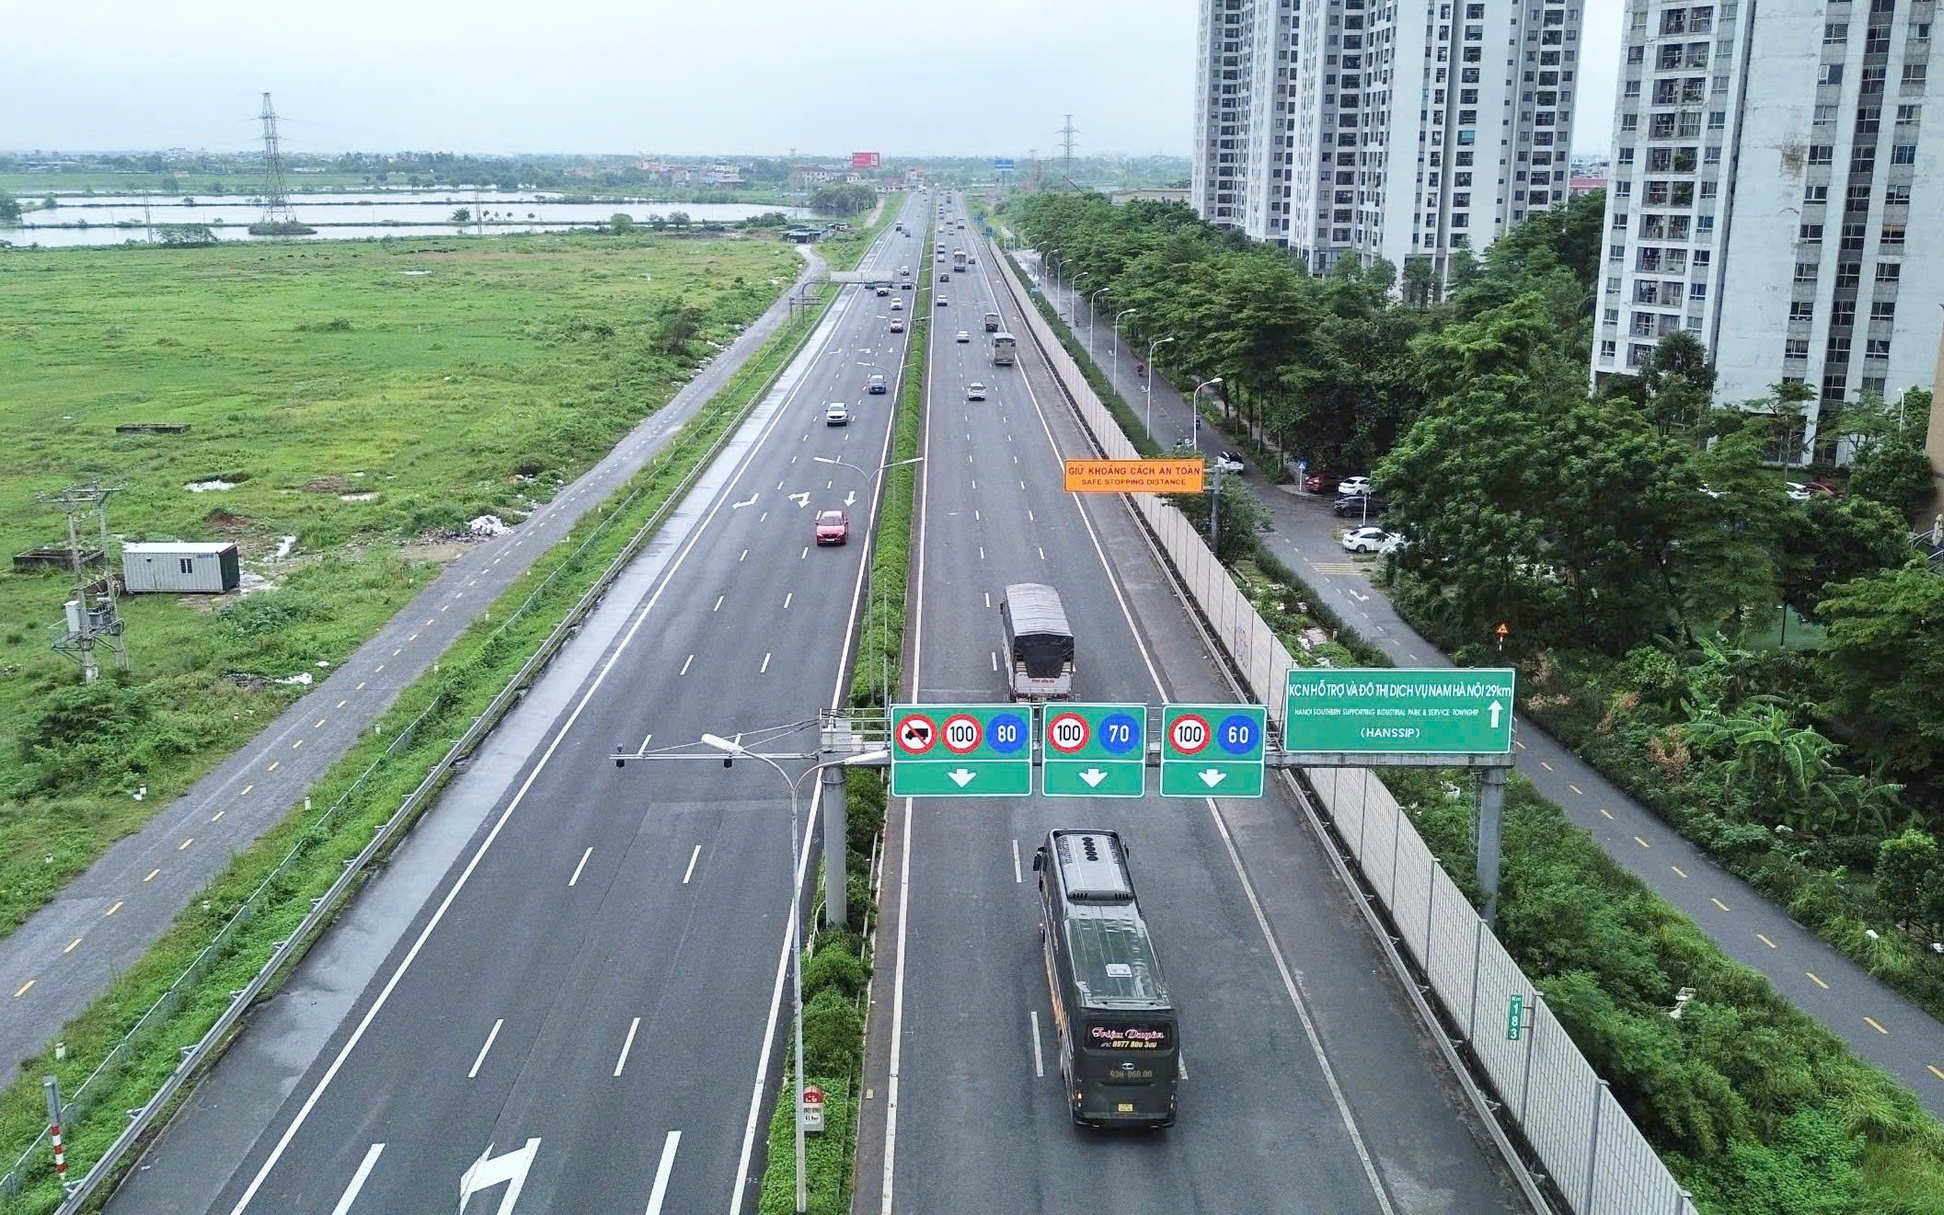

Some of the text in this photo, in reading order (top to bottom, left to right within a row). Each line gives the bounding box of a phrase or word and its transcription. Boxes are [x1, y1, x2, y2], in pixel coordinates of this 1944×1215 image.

[1069, 464, 1200, 475] GIỮ KHOẢNG CÁCH AN TOÀN
[1289, 684, 1310, 696] KCN
[1310, 679, 1326, 696] HỖ
[1326, 682, 1345, 698] TRỢ
[1346, 681, 1358, 696] VÀ
[1358, 681, 1374, 696] ĐÔ
[1375, 684, 1389, 698] THỊ
[1390, 684, 1414, 698] DỊCH
[1414, 684, 1428, 698] VỤ
[1428, 684, 1452, 696] NAM
[1452, 681, 1466, 697] HÀ
[1467, 682, 1485, 698] NỘI
[1294, 708, 1480, 716] HANOI SOUTHERN SUPPORTING INDUSTRIAL PARK & SERVICE TOWNSHIP
[949, 725, 1016, 742] 100 80
[1057, 724, 1130, 743] 100 70
[1178, 726, 1249, 743] 100 60
[1360, 728, 1420, 738] (HANSSIP)
[1510, 1003, 1519, 1039] 183
